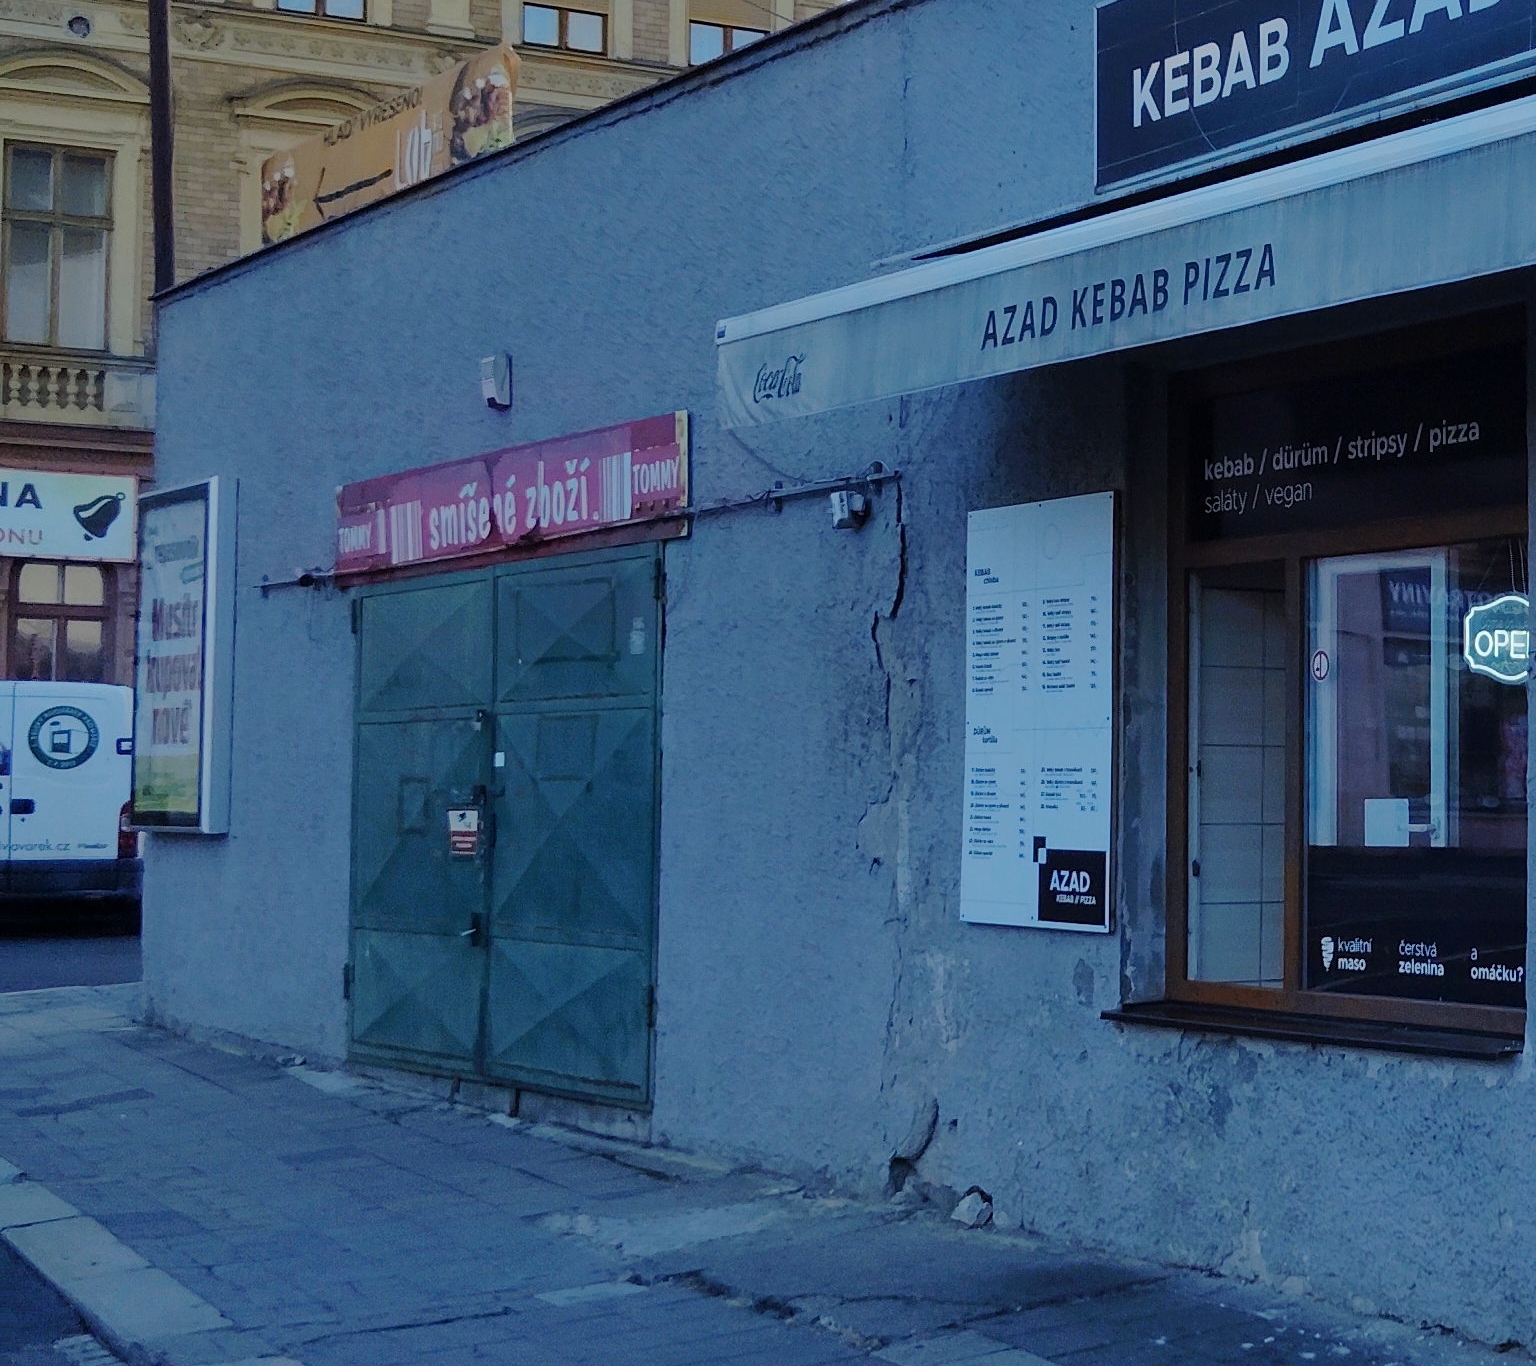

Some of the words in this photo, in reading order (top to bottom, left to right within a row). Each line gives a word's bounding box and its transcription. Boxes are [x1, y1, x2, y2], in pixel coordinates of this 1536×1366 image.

[1132, 16, 1289, 128] KEBAB
[981, 297, 1057, 351] AZAD
[1071, 269, 1169, 330] KEBAB
[1183, 243, 1276, 306] PIZZA
[1205, 452, 1254, 480] kebab
[1272, 442, 1328, 471] dürüm
[1348, 431, 1407, 460] stripsy
[1429, 419, 1480, 452] pizza
[633, 456, 680, 495] TOMMY
[1205, 488, 1247, 515] saláty
[1265, 482, 1312, 508] vegan
[1474, 630, 1529, 659] OPE
[1050, 870, 1090, 892] AZAD
[1056, 894, 1074, 903] KEBAB
[1080, 895, 1096, 905] PIZZA
[1338, 937, 1372, 953] kvalitní
[1399, 939, 1437, 957] čerstvá
[1471, 948, 1477, 960] a
[1338, 957, 1366, 971] maso
[1399, 960, 1444, 977] zelenina
[1470, 965, 1523, 982] omáčku?
